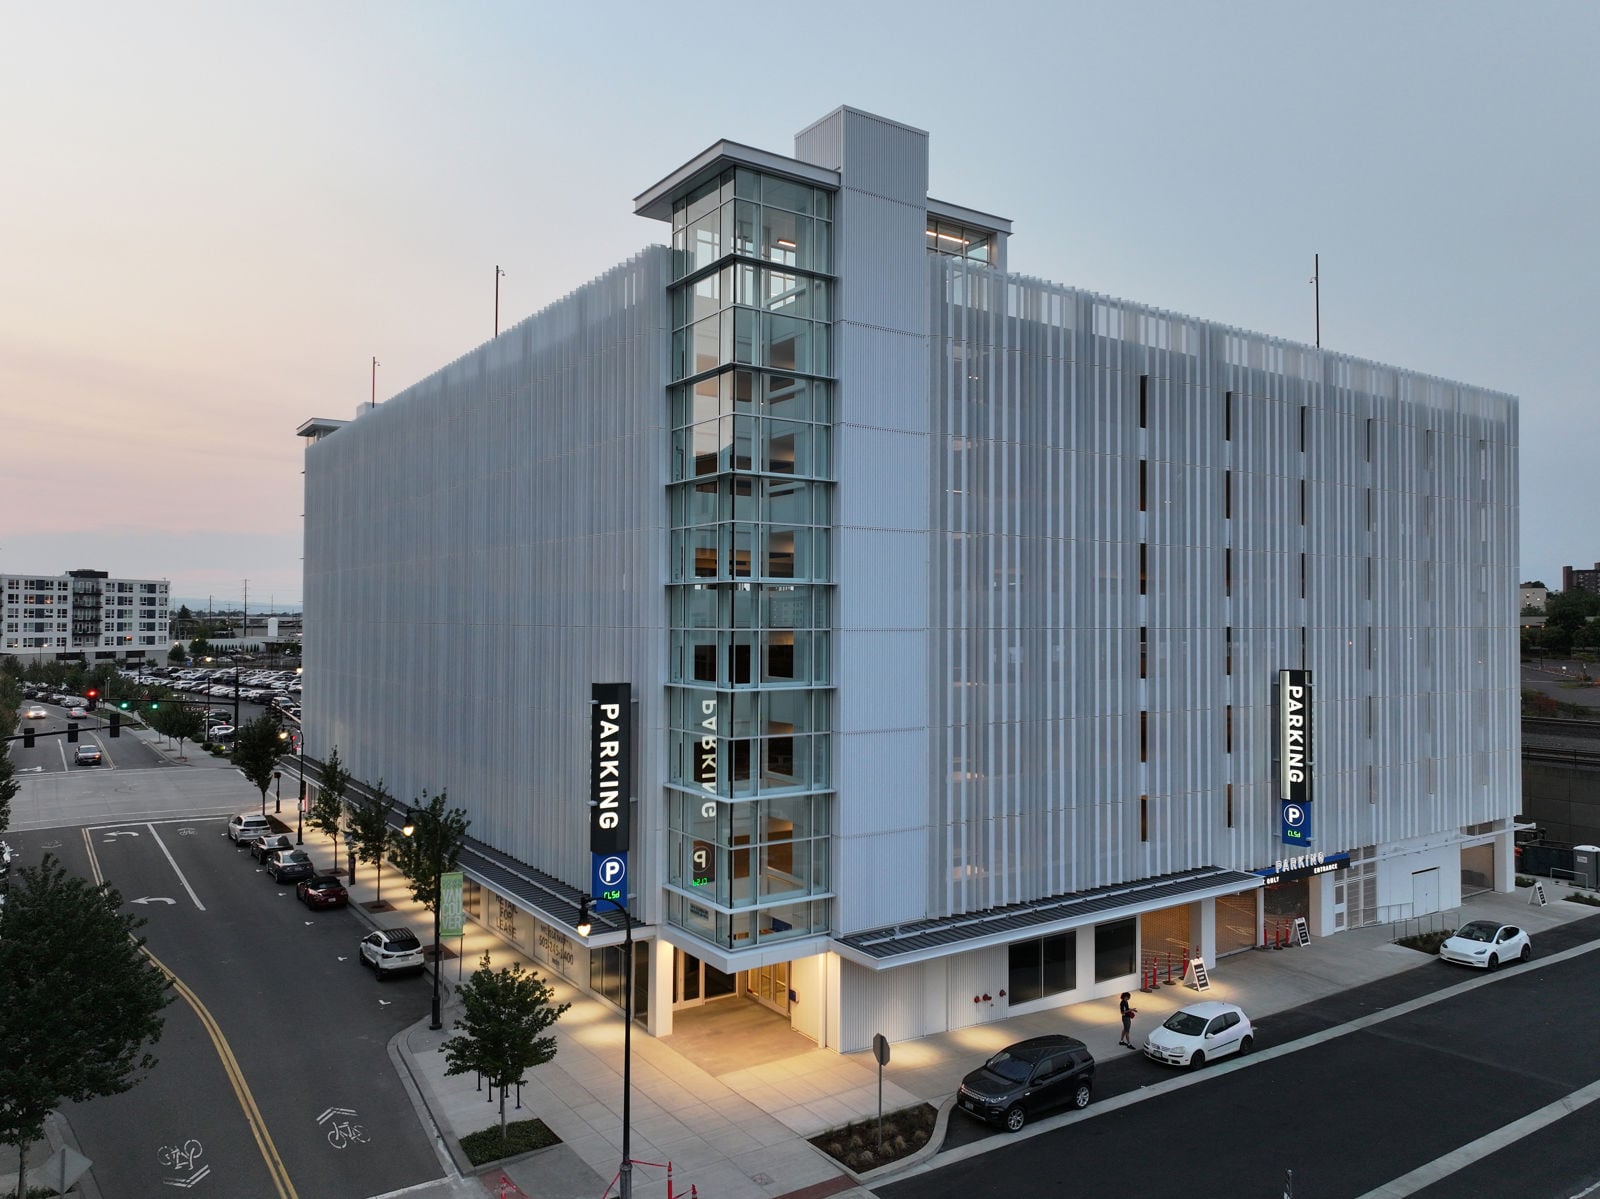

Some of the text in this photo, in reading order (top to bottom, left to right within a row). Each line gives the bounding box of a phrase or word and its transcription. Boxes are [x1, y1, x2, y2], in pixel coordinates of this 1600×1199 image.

[1288, 685, 1304, 783] PARKING
[599, 703, 620, 829] PARKING
[1288, 808, 1300, 822] P
[605, 861, 620, 882] P
[1275, 851, 1325, 874] PARKING
[1313, 863, 1338, 875] ENTRANCE
